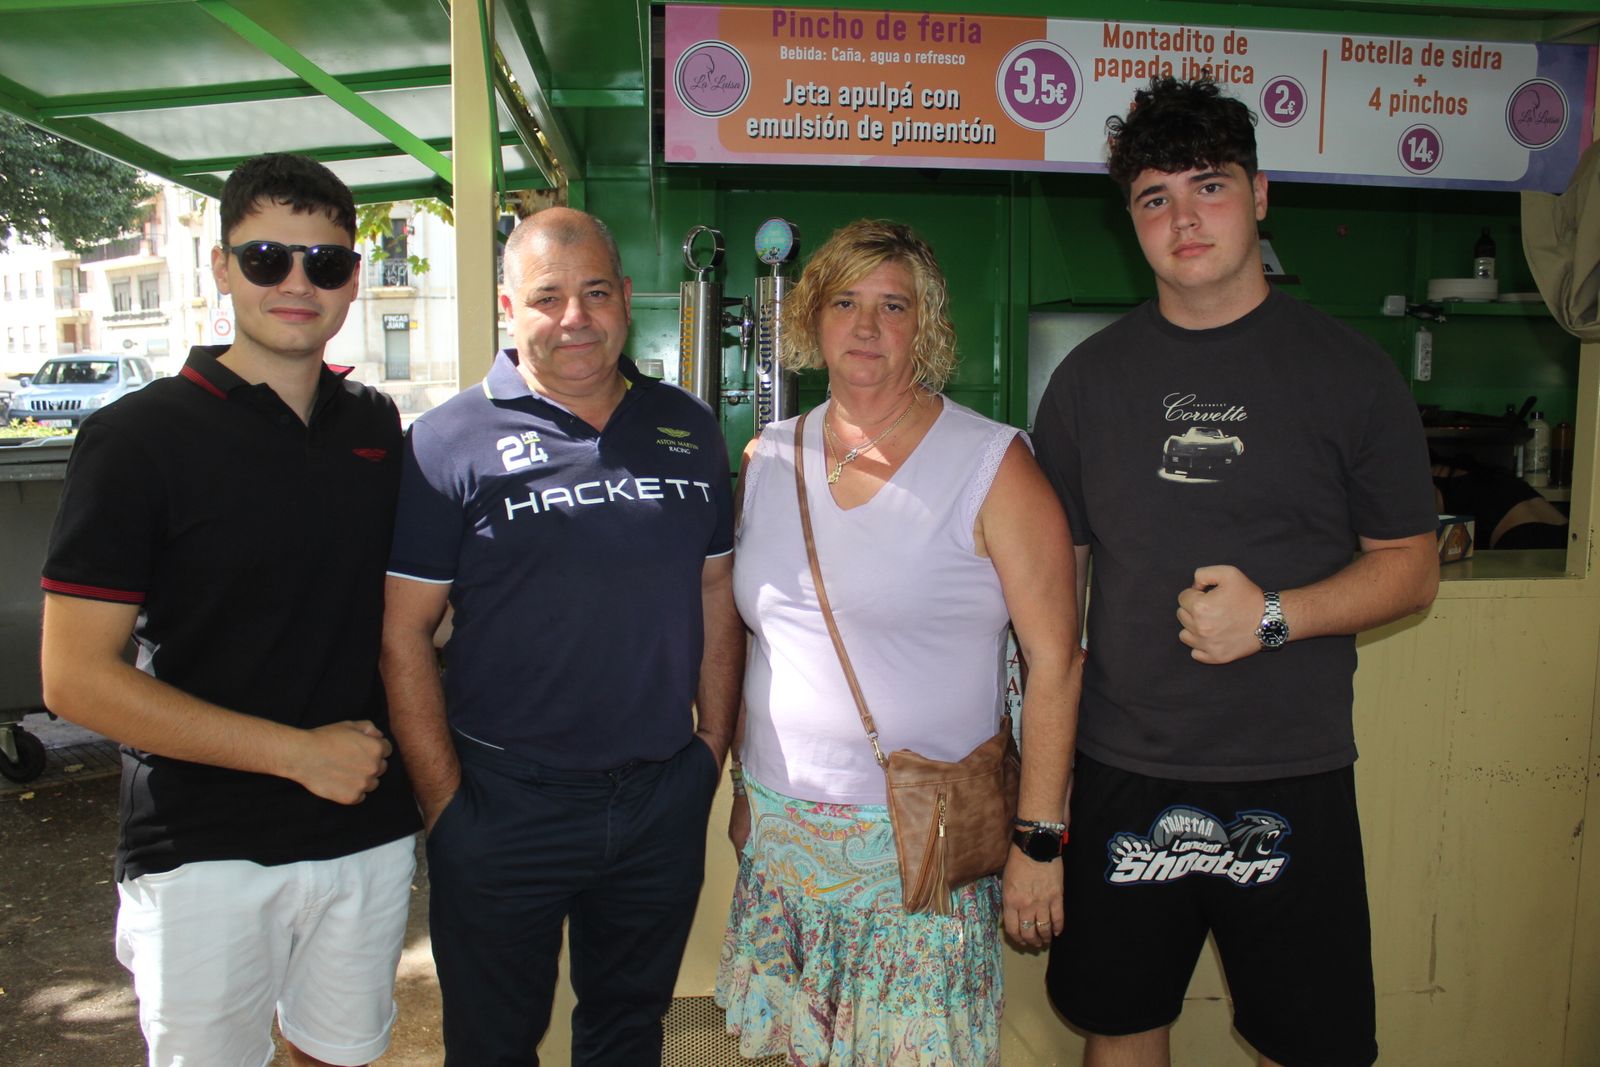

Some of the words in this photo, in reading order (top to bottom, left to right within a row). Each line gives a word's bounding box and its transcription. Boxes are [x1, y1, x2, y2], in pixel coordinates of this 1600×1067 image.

[773, 10, 864, 40] Pincho
[876, 15, 907, 41] de
[918, 15, 983, 44] feria
[1103, 23, 1216, 54] Montadito
[1223, 30, 1249, 55] de
[780, 46, 827, 61] Bebida:
[831, 47, 866, 63] Caña,
[870, 52, 899, 65] agua
[903, 53, 911, 63] o
[915, 51, 966, 65] refresco
[1341, 37, 1413, 65] Botella
[1421, 42, 1444, 66] de
[1452, 45, 1502, 70] sidra
[1013, 58, 1068, 105] 3,5€
[1094, 55, 1173, 82] papada
[1182, 57, 1254, 84] ibérica
[782, 79, 830, 106] Jeta
[839, 81, 914, 114] apulpá
[920, 87, 961, 110] con
[1274, 85, 1296, 115] 2€
[1369, 87, 1381, 111] 4
[1389, 90, 1468, 117] pinchos
[746, 113, 850, 139] emulsión
[857, 115, 884, 140] de
[890, 118, 996, 146] pimentón
[1408, 136, 1433, 164] 14€
[1163, 392, 1248, 422] Corvette
[504, 478, 710, 520] HACKETT
[1160, 816, 1214, 837] TRAPSTAR
[1172, 839, 1222, 853] London
[1109, 850, 1285, 883] Shooters
